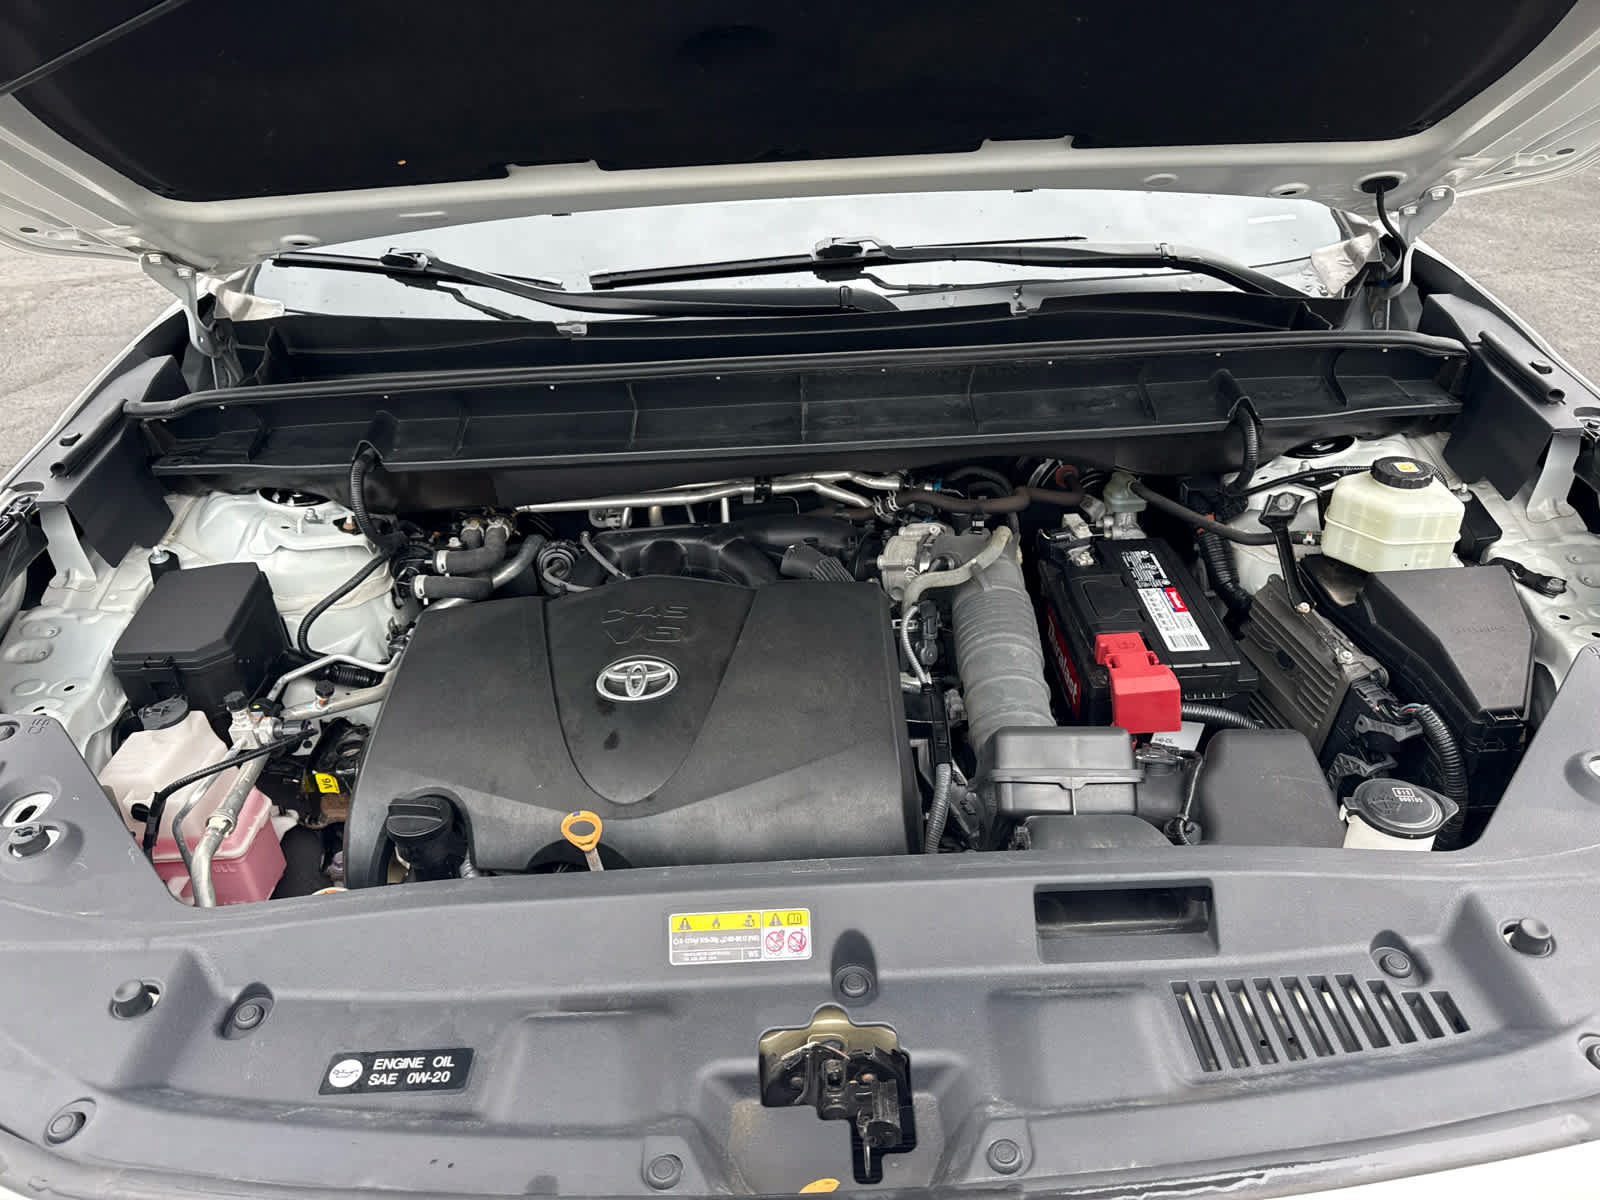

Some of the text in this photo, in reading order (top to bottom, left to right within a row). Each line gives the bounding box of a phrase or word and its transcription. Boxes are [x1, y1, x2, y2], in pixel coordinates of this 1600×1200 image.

[372, 1055, 455, 1070] ENGINE OIL
[368, 1071, 451, 1086] SAE 0W-20
